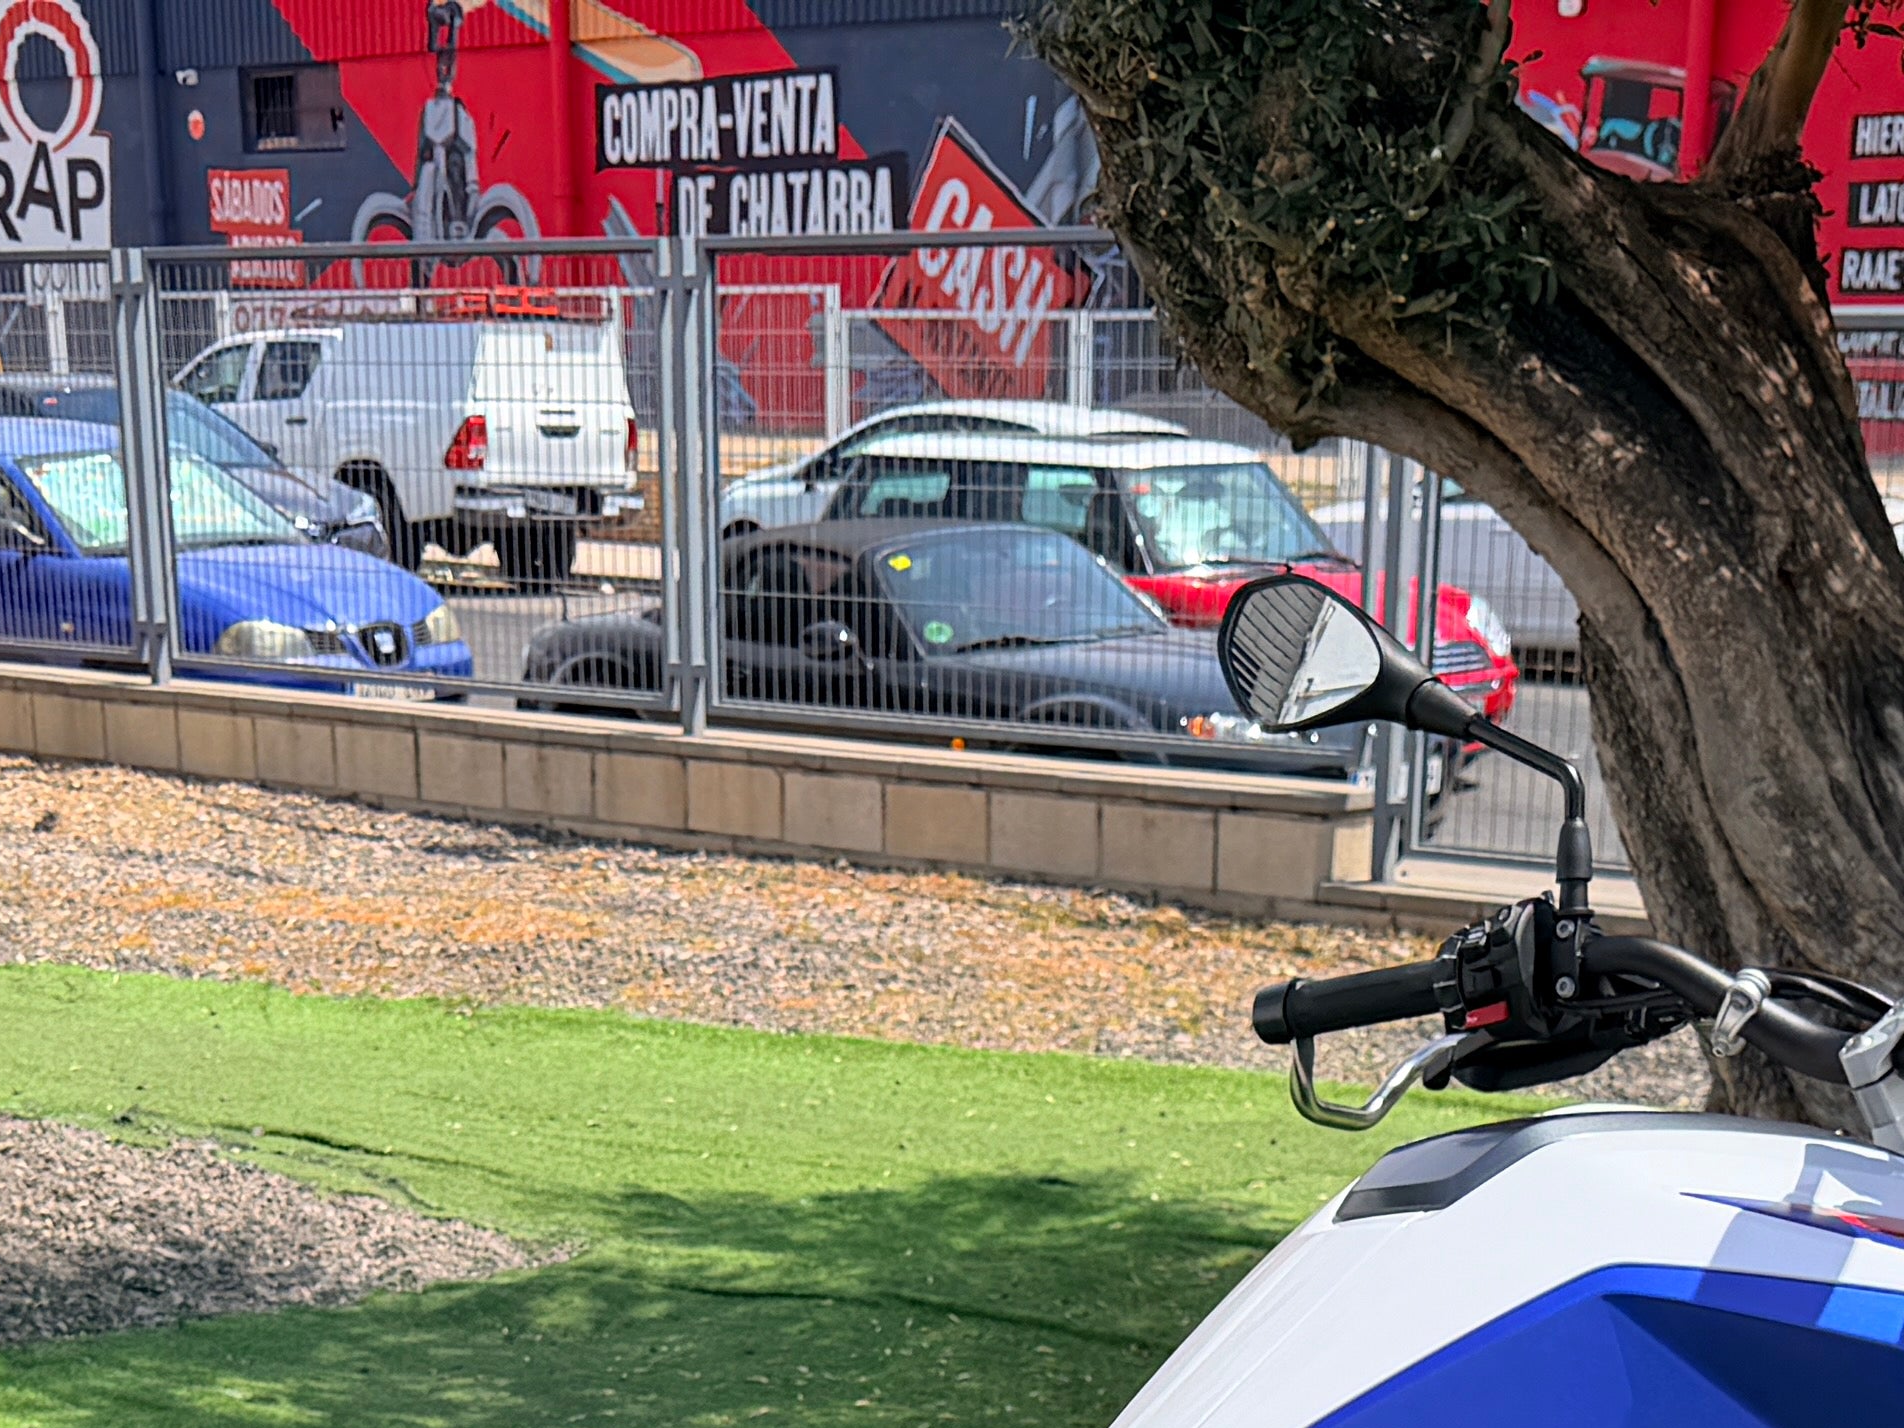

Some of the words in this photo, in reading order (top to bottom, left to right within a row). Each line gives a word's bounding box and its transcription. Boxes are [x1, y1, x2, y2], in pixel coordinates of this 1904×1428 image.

[603, 73, 836, 164] COMPRA-VENTA
[678, 174, 715, 236] DE
[729, 166, 894, 236] CHATARRA
[918, 178, 1054, 368] CASH
